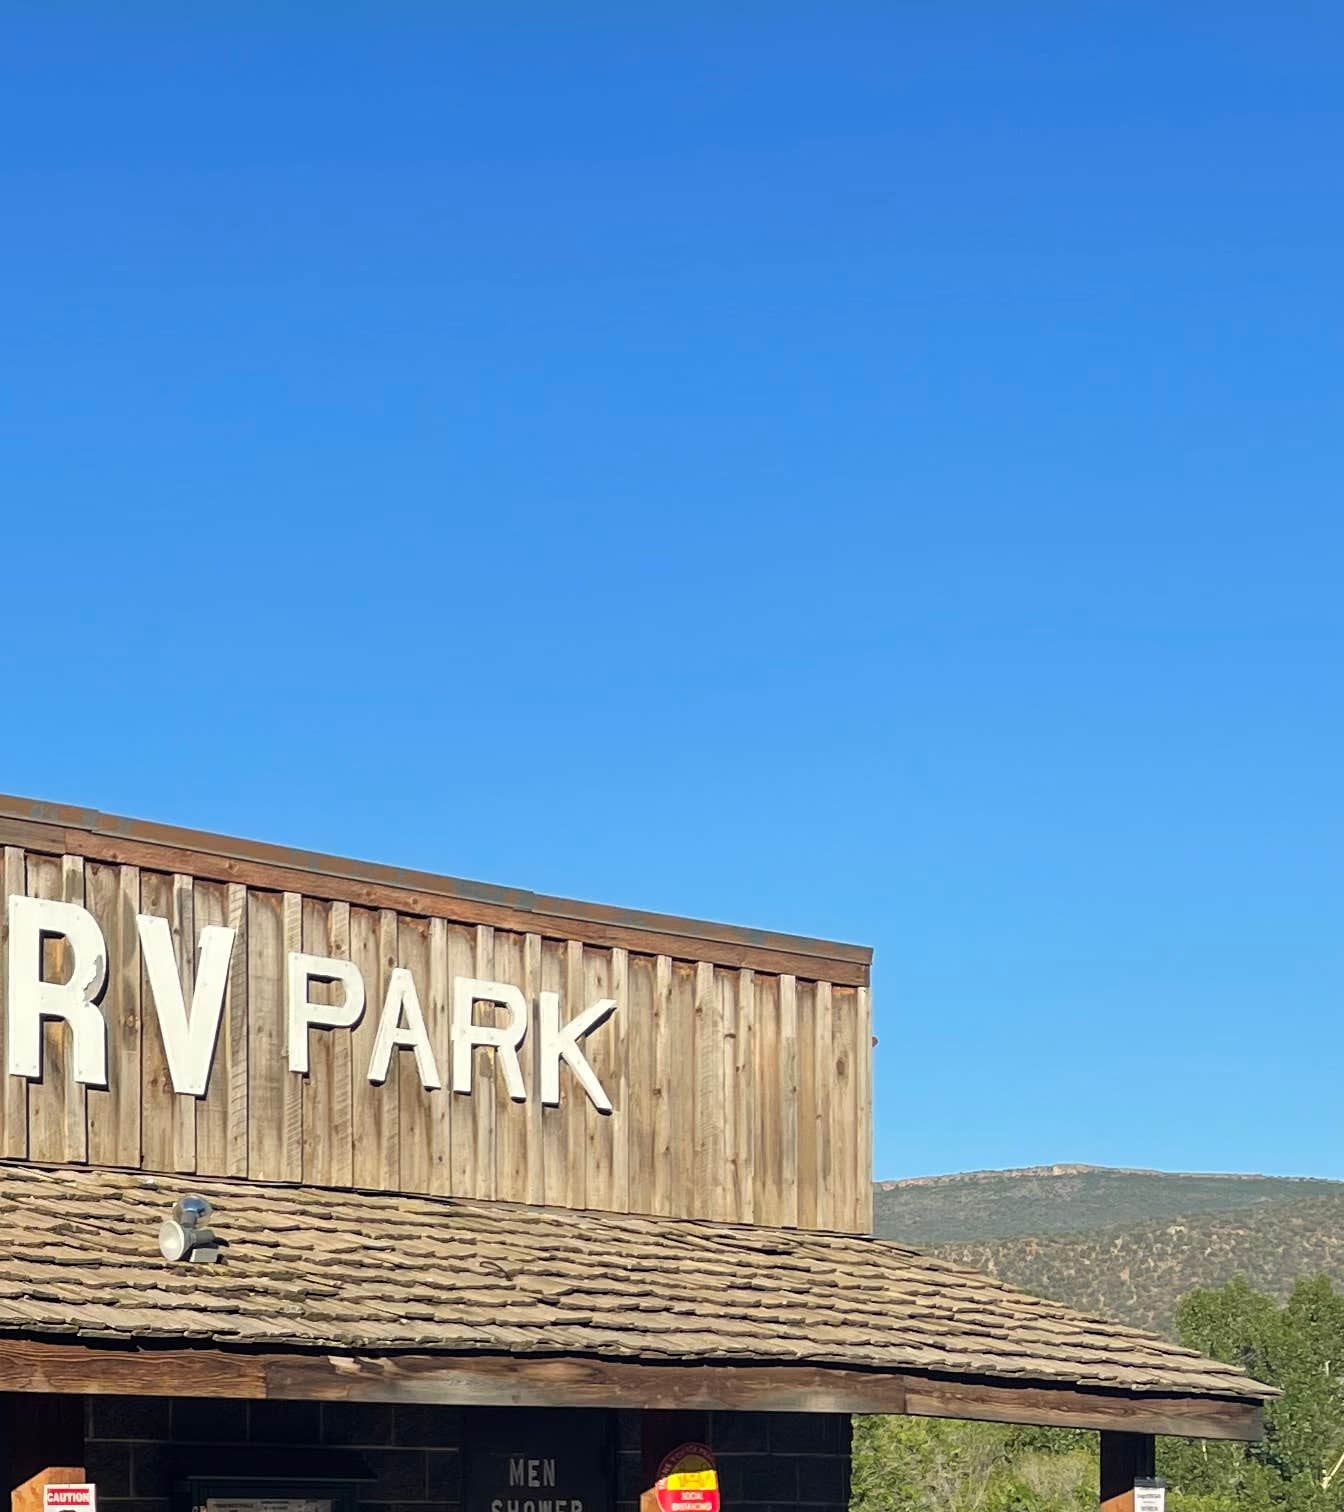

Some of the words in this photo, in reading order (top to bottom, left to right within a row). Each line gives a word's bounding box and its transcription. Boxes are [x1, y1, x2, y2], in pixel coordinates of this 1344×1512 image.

[8, 894, 236, 1097] RV
[286, 951, 618, 1114] PARK
[510, 1458, 556, 1488] MEN
[47, 1492, 89, 1503] CAUTION
